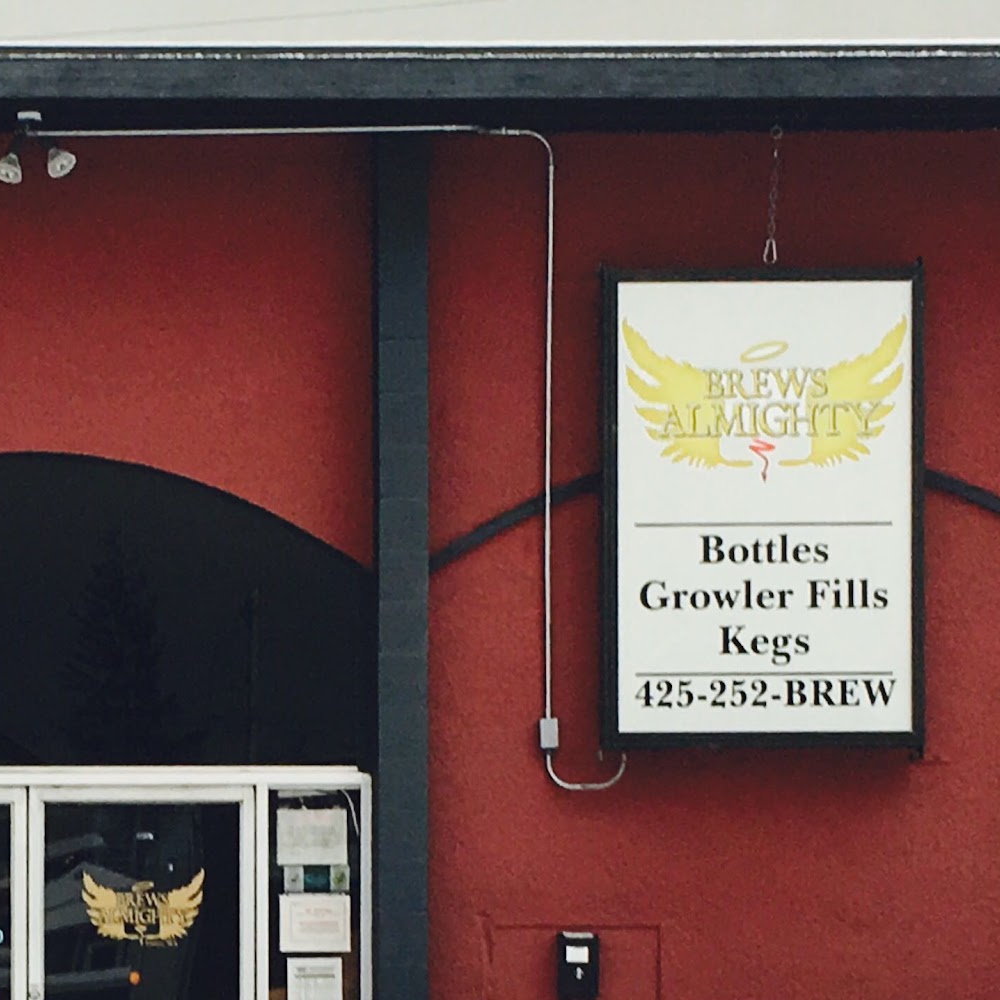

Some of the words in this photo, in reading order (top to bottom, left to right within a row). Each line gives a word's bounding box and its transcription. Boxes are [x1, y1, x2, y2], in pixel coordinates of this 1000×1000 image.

[704, 368, 829, 400] BREWS
[658, 400, 882, 438] ALMIGHTY
[700, 533, 829, 564] Bottles
[639, 579, 794, 610] Growler
[808, 578, 889, 609] Fills
[719, 625, 810, 665] Kegs
[635, 679, 896, 709] 425-252-BREW
